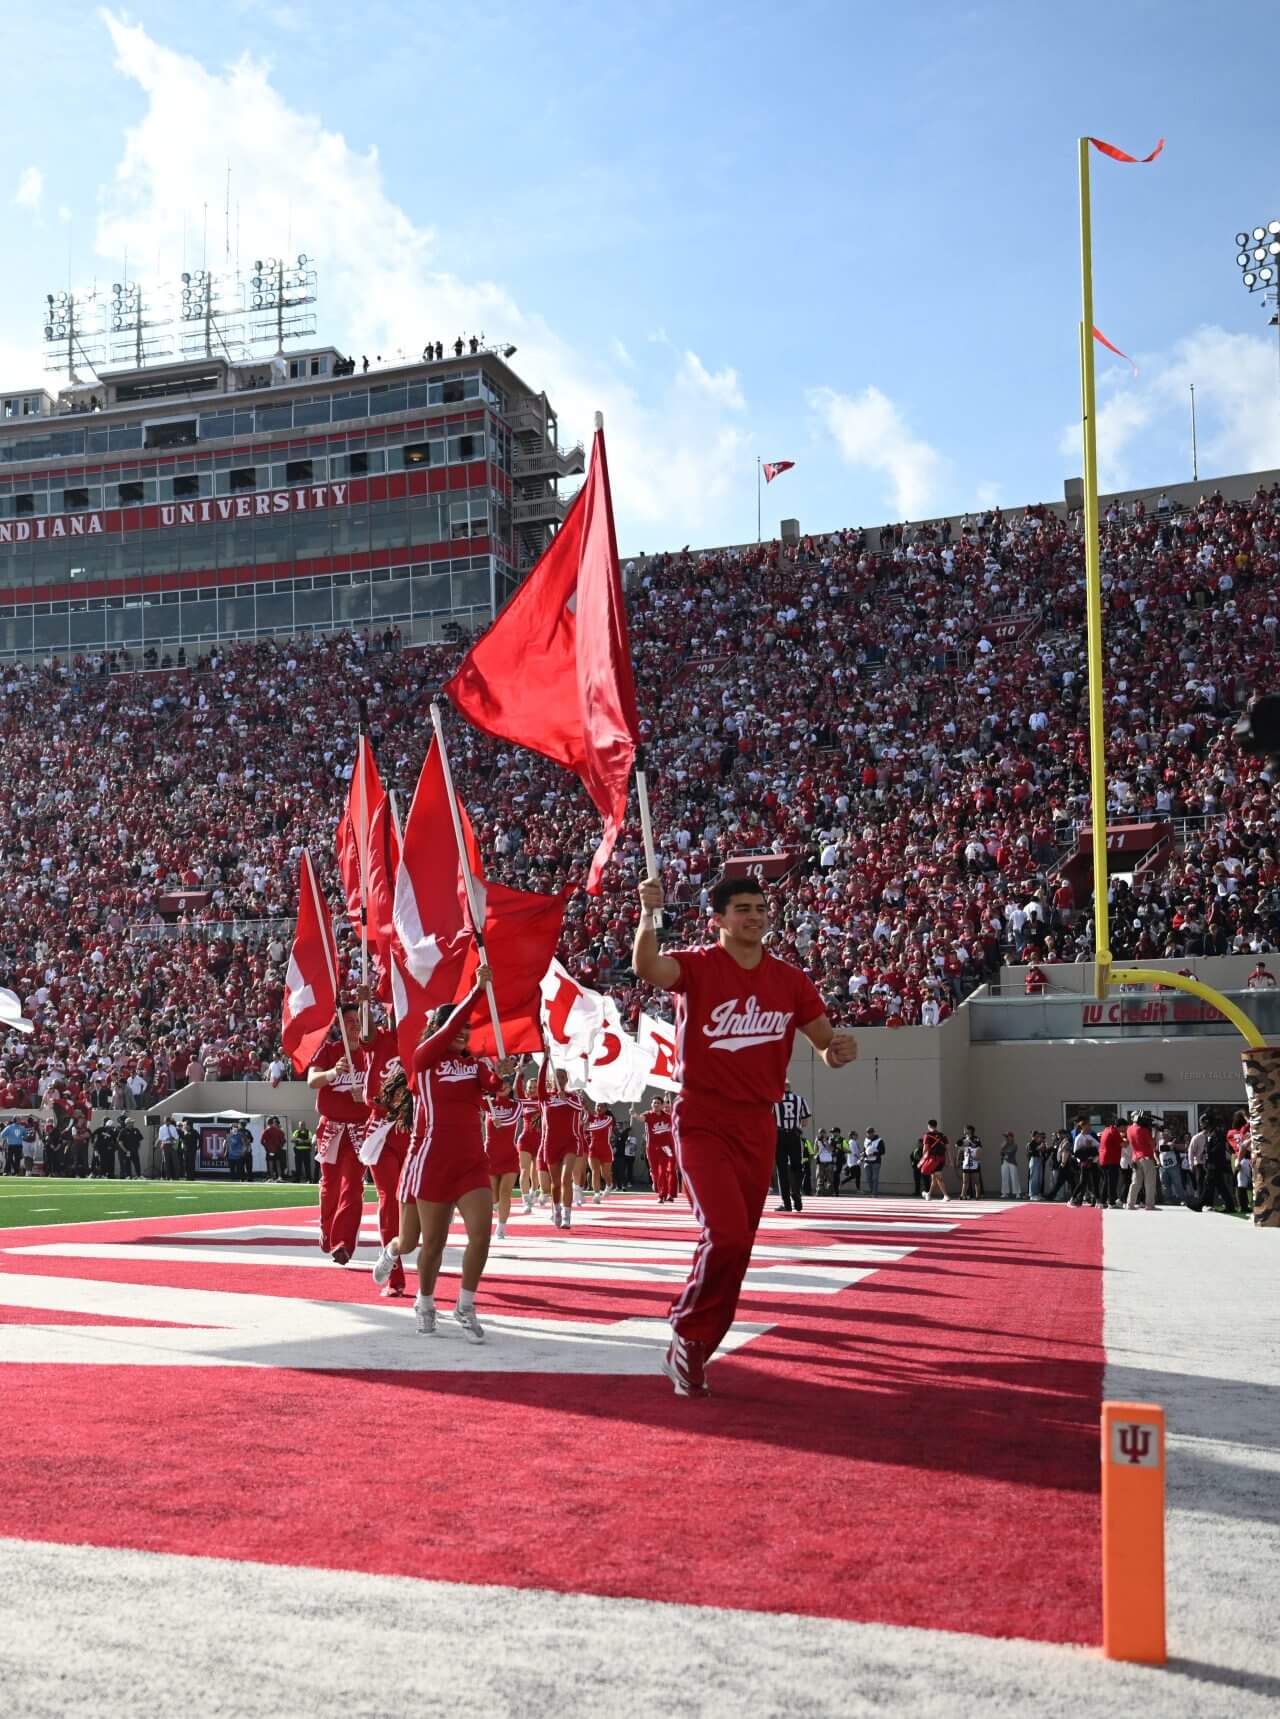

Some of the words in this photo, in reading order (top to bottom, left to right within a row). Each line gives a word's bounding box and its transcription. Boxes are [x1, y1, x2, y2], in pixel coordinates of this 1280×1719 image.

[161, 484, 348, 527] UNIVERSITY
[192, 713, 208, 723] 107
[1106, 834, 1125, 849] 11
[746, 864, 764, 877] 10
[178, 899, 186, 909] 8
[703, 994, 794, 1037] Indiana
[1083, 1005, 1104, 1024] IU
[1108, 1000, 1168, 1023] Credit
[783, 1101, 796, 1118] R
[1117, 1424, 1152, 1464] IU
